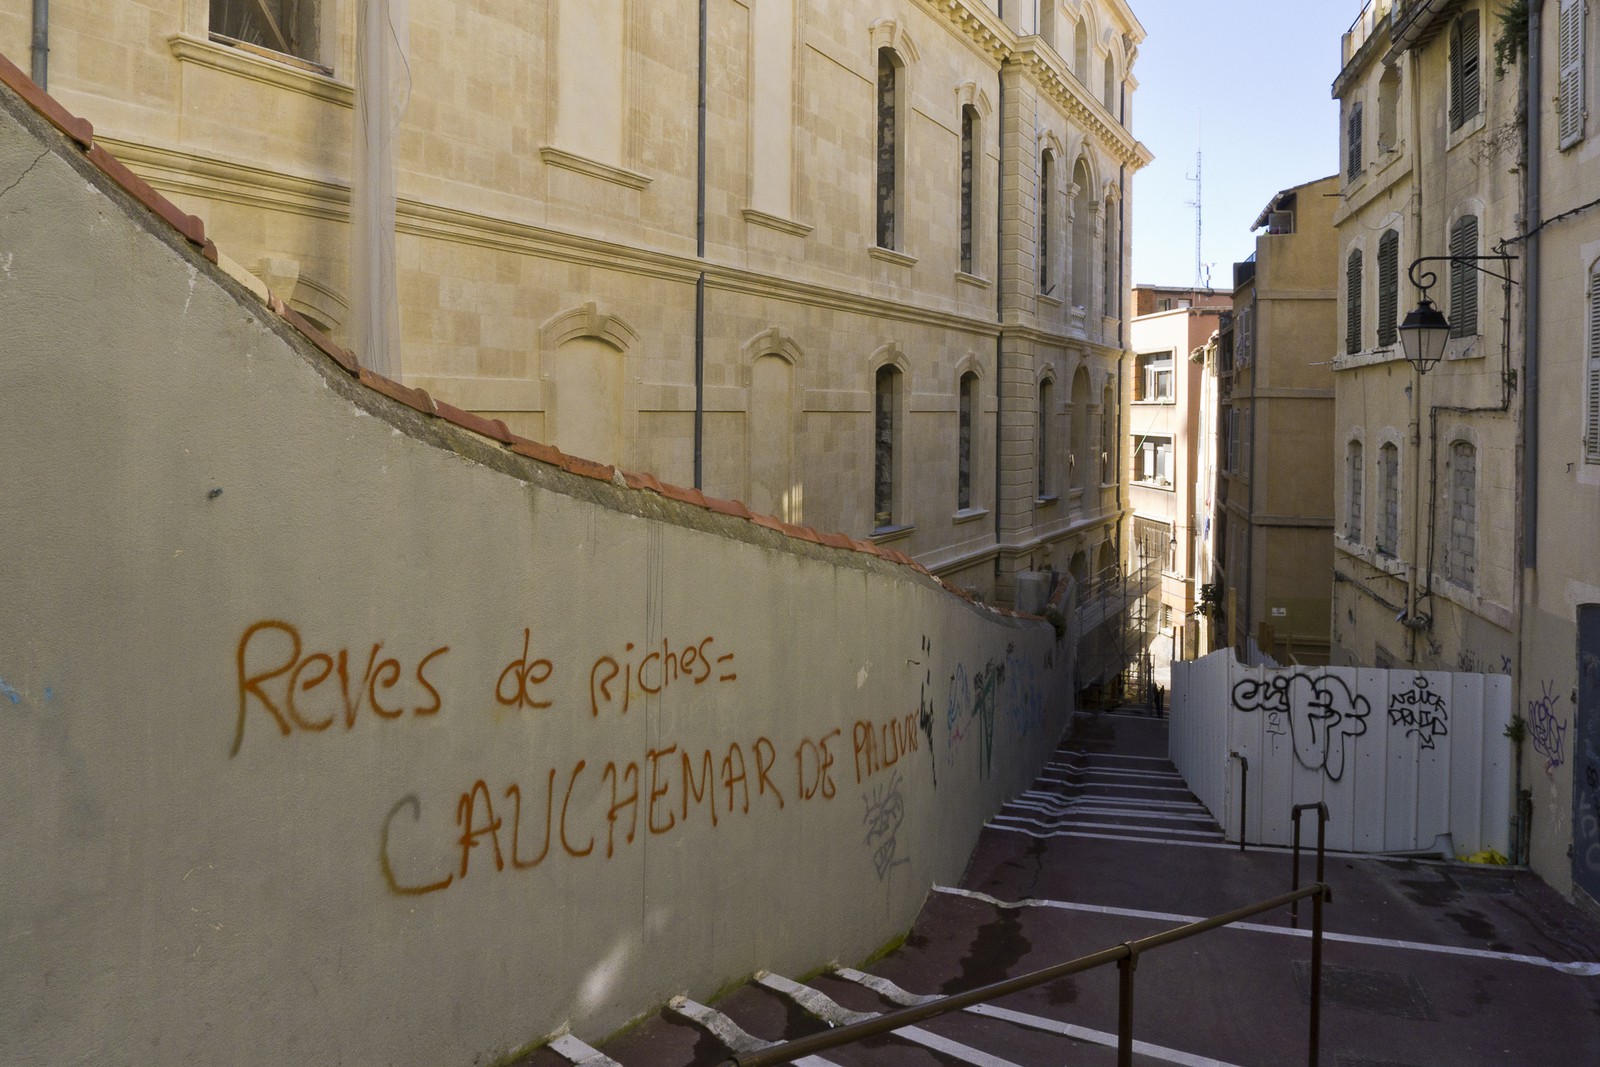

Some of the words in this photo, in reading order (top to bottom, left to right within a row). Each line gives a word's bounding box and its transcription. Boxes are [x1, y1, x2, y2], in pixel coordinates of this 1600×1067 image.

[495, 627, 553, 710] de
[378, 736, 785, 895] CAUCHEMAR
[794, 728, 841, 801] DE
